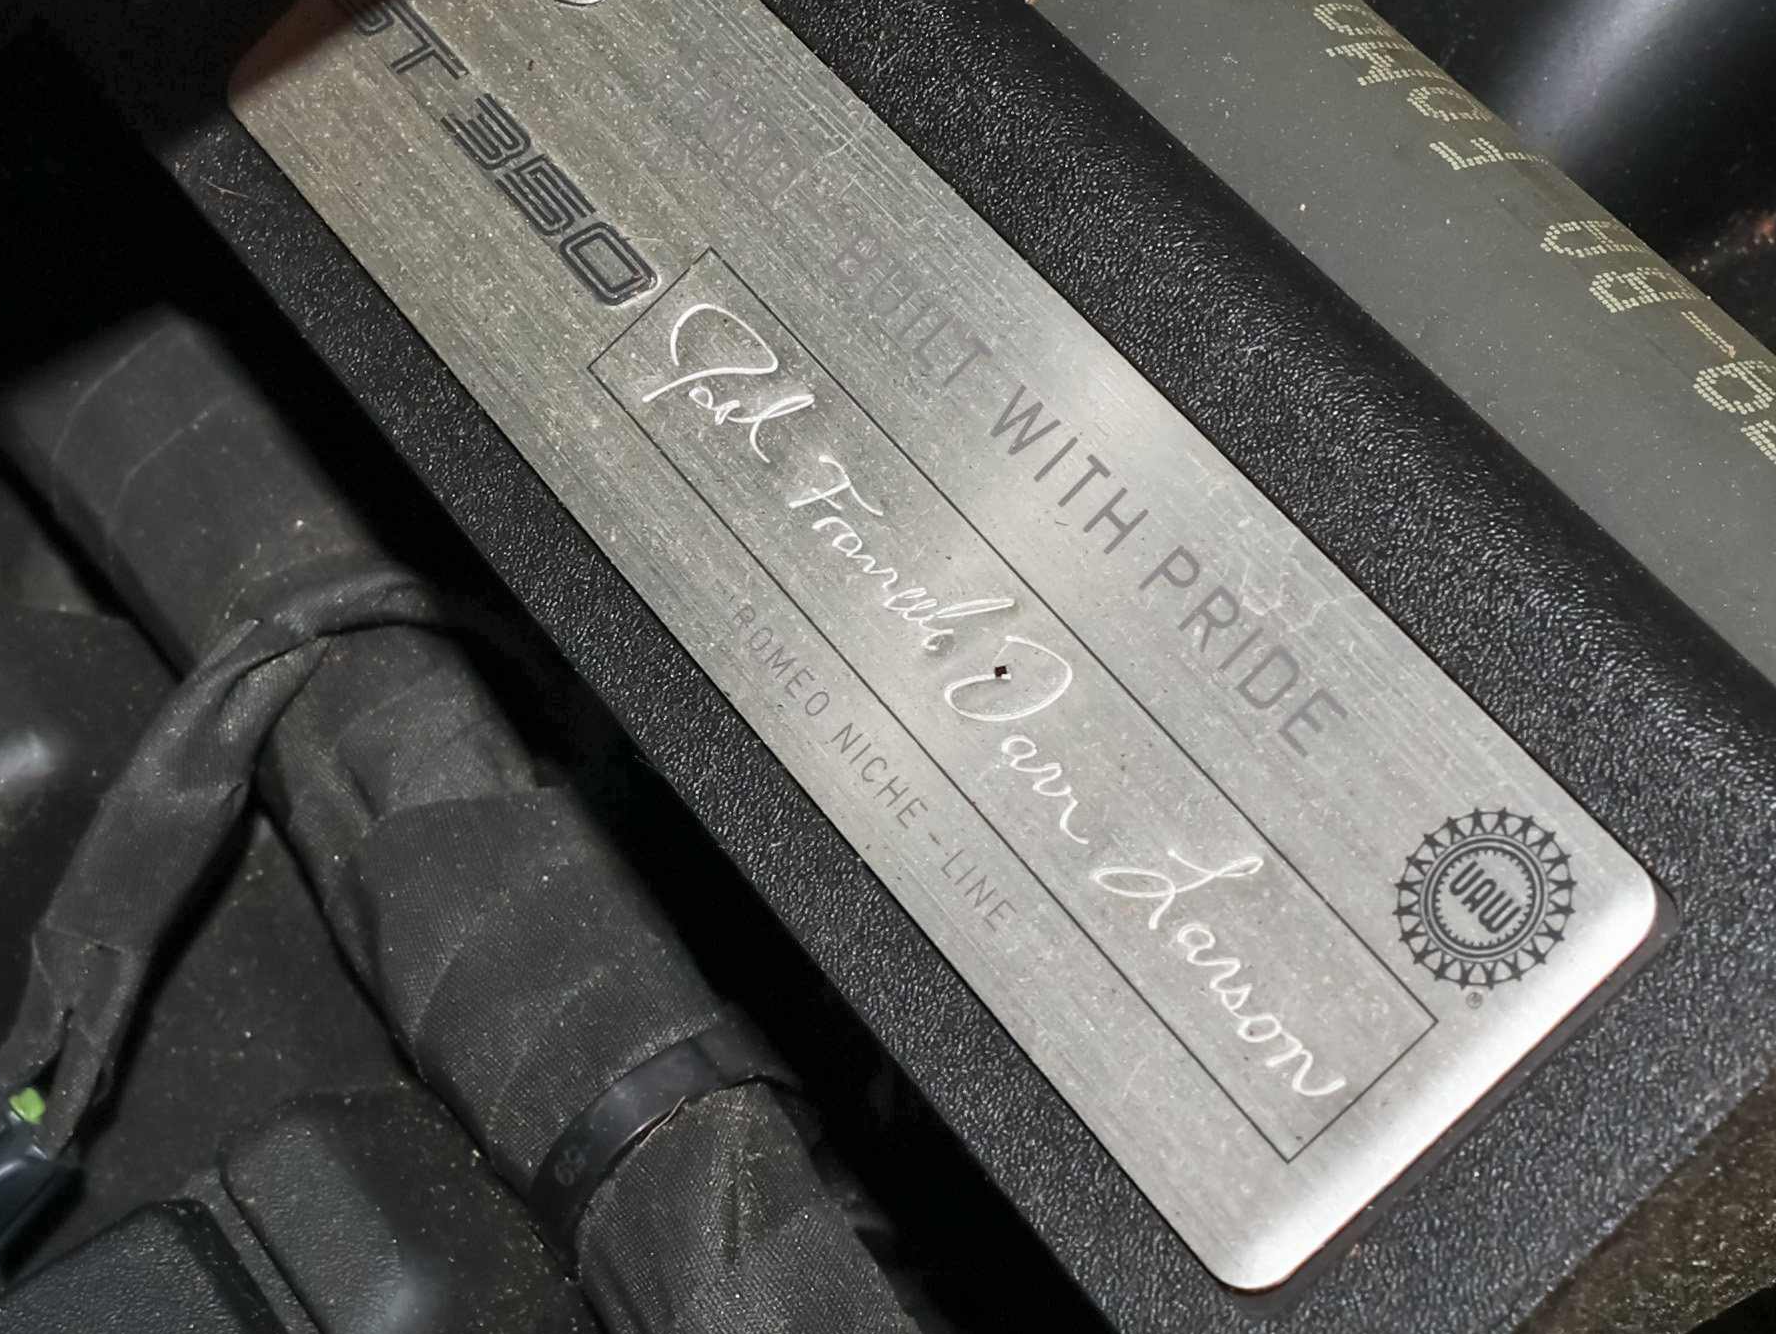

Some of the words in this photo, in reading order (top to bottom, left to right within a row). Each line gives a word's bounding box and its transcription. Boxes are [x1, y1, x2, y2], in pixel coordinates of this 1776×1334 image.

[440, 91, 660, 308] 350
[731, 607, 832, 720] ROMEO
[989, 385, 1150, 554] WITH
[1138, 545, 1349, 759] PRIDE
[1089, 848, 1346, 1098] Larson
[1448, 860, 1522, 934] UAW
